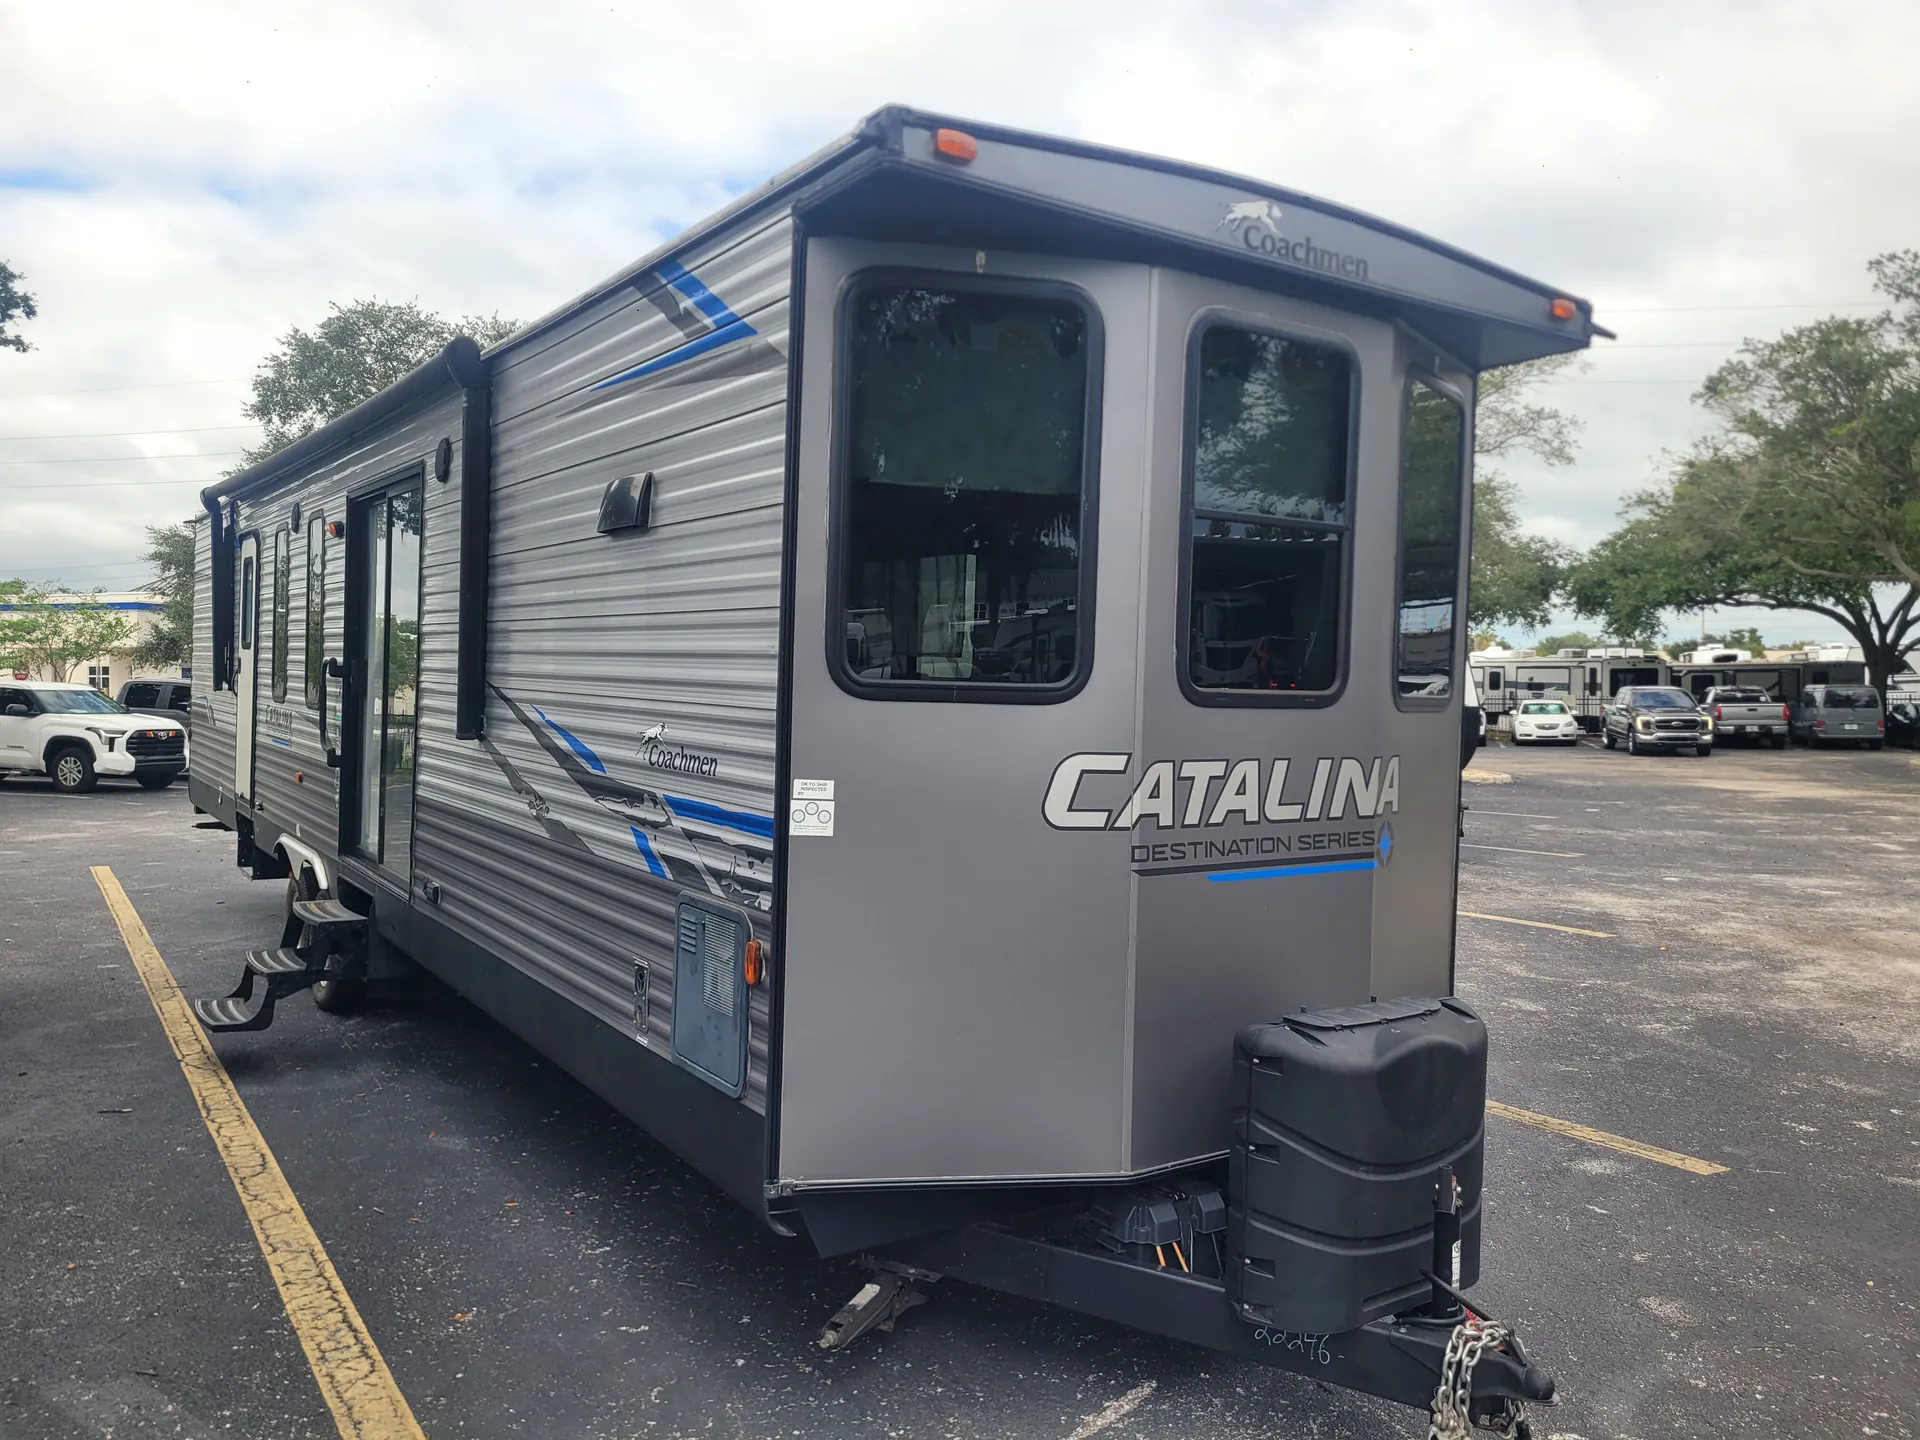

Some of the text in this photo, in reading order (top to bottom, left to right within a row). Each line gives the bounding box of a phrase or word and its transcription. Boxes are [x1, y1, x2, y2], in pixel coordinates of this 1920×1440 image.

[1243, 225, 1369, 280] Coachmen
[648, 744, 718, 777] Coachmen
[1041, 751, 1400, 831] CATALINA
[1131, 830, 1376, 863] DESTINATION SERIES
